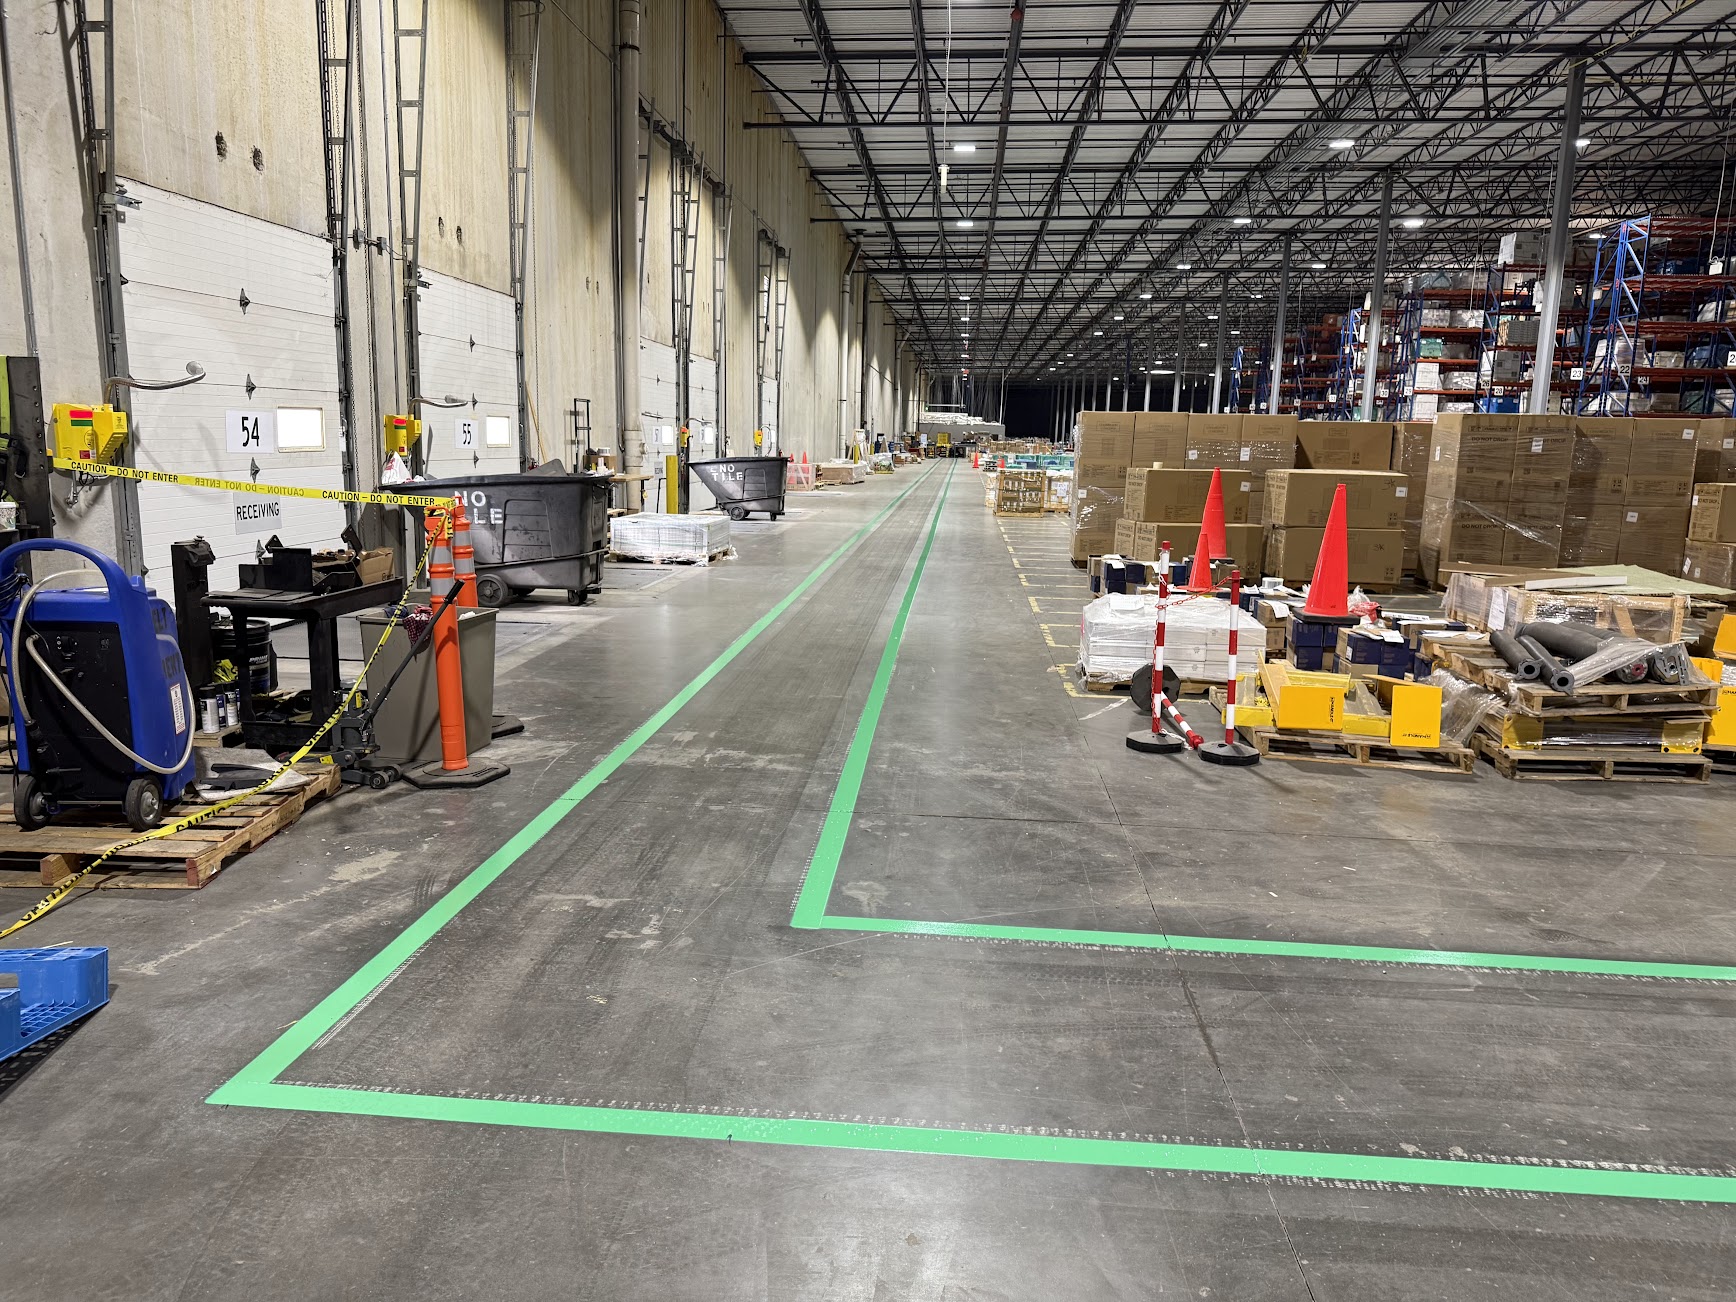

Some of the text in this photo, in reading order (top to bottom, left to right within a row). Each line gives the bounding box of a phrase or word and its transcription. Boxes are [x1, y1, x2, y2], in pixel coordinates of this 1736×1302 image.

[242, 416, 260, 447] 54
[463, 423, 472, 445] 55
[71, 461, 178, 483] CAUTION DO NOT ENTER
[712, 472, 743, 481] TILE
[720, 464, 735, 472] NO
[322, 490, 360, 501] CAUTION
[370, 494, 382, 502] DO
[386, 495, 403, 504] NOT
[408, 496, 435, 506] ENTER
[237, 502, 279, 520] RECEIVING
[474, 508, 503, 524] LE
